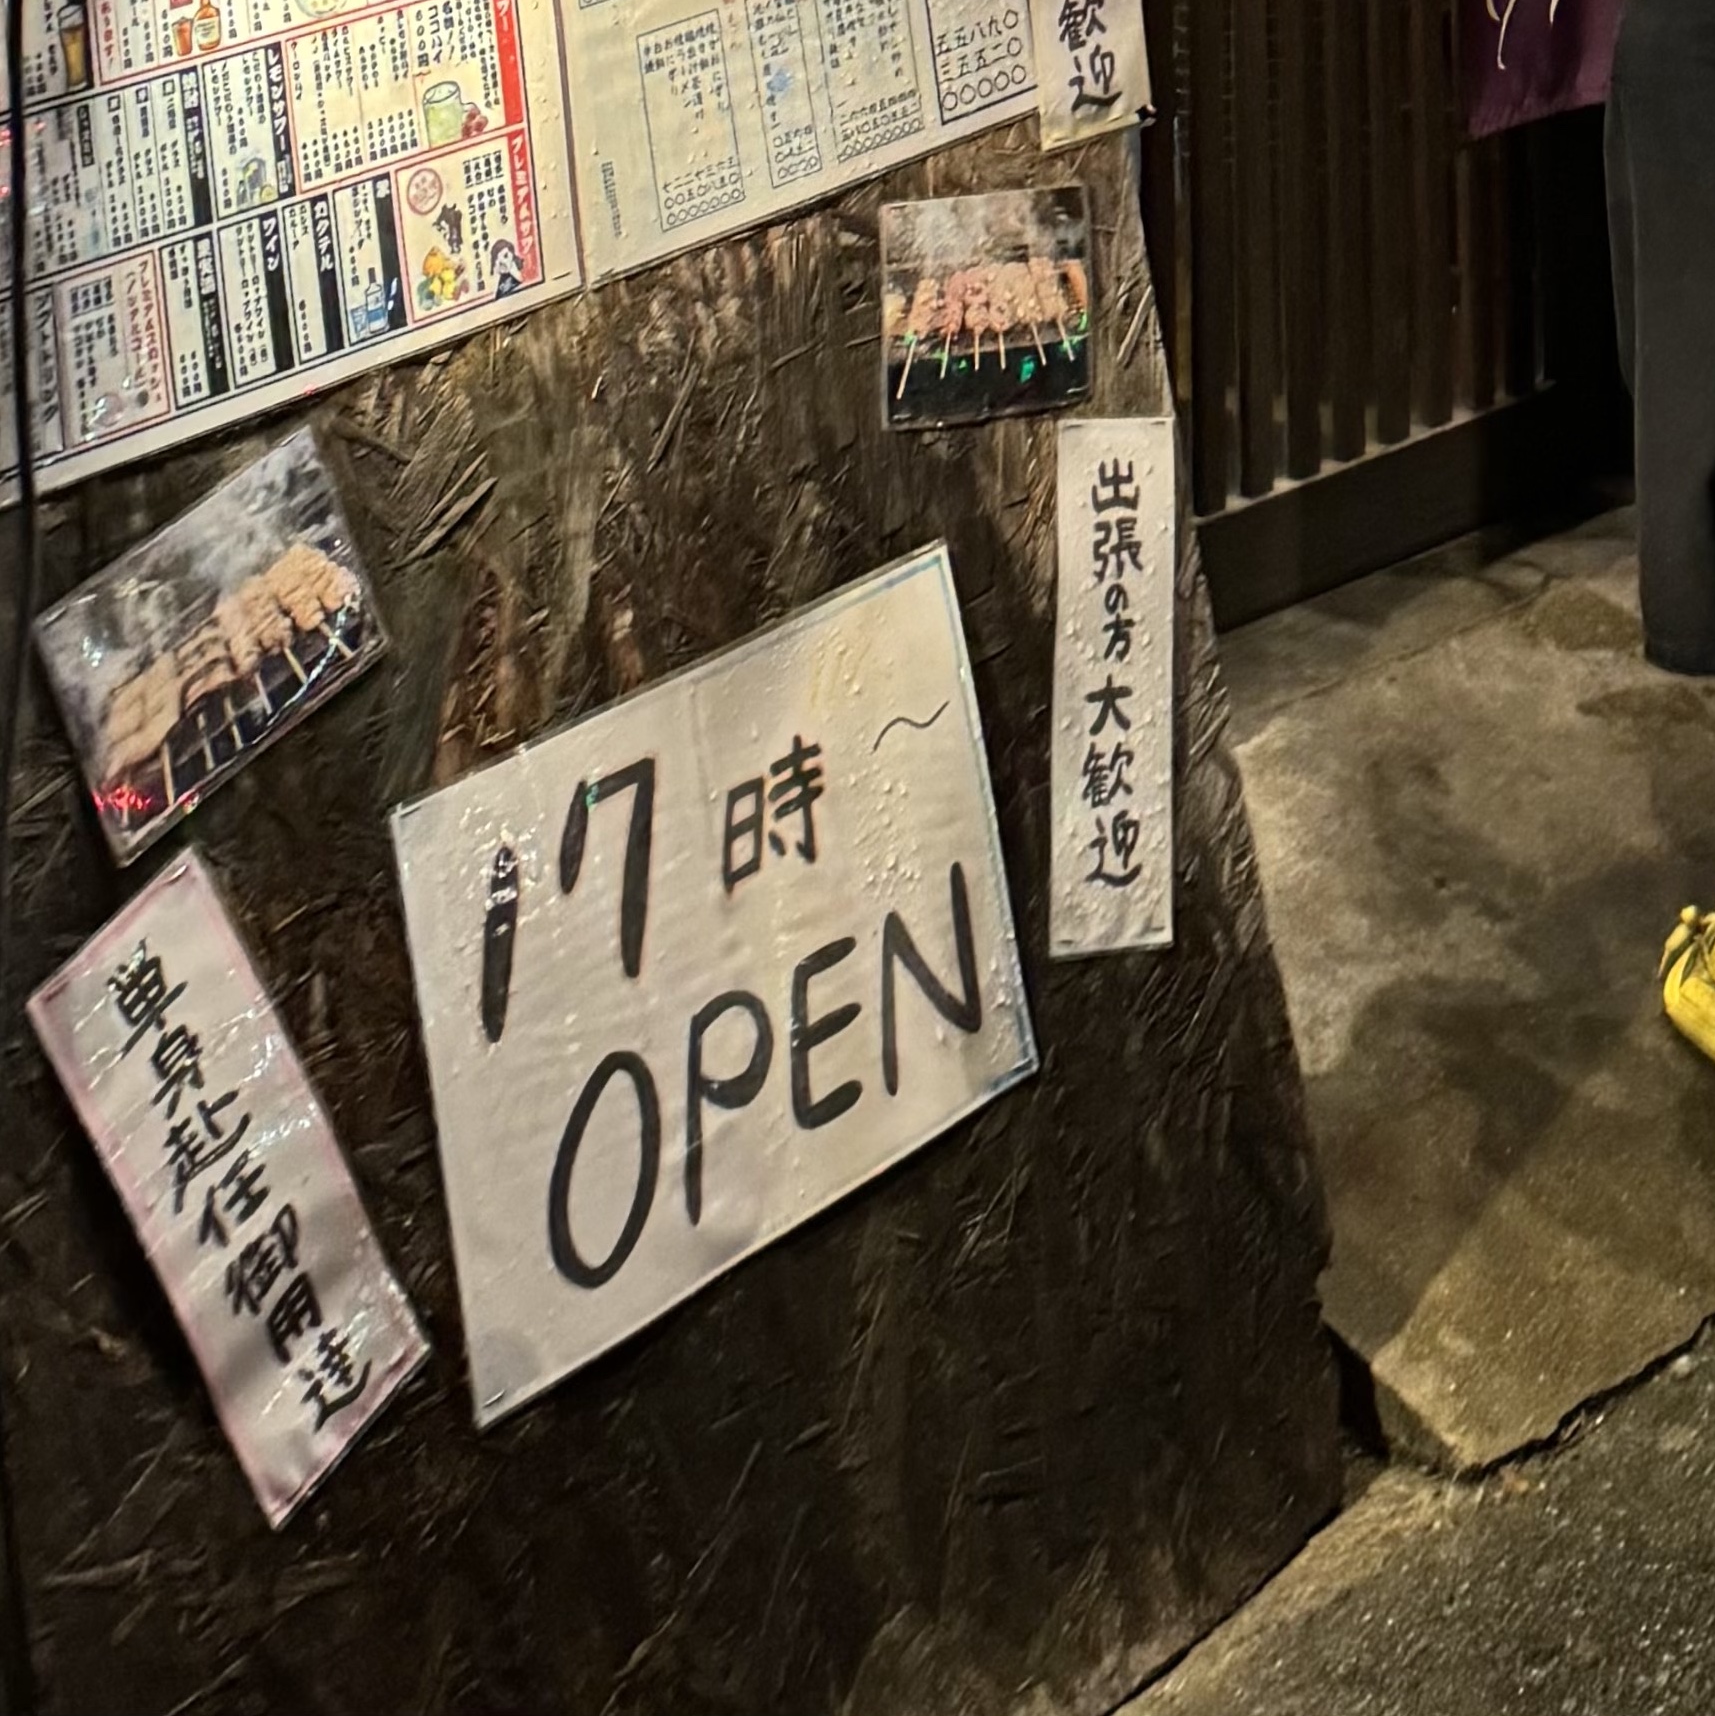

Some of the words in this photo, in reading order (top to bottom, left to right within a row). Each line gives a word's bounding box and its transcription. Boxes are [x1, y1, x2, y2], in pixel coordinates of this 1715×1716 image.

[267, 49, 286, 151] レモンサワー
[263, 218, 280, 271] ワイン
[314, 201, 333, 272] カクテル
[1082, 457, 1144, 888] 出張の方大歓迎
[107, 933, 373, 1433] 単身赴任御用達
[549, 861, 983, 1288] OPEN
